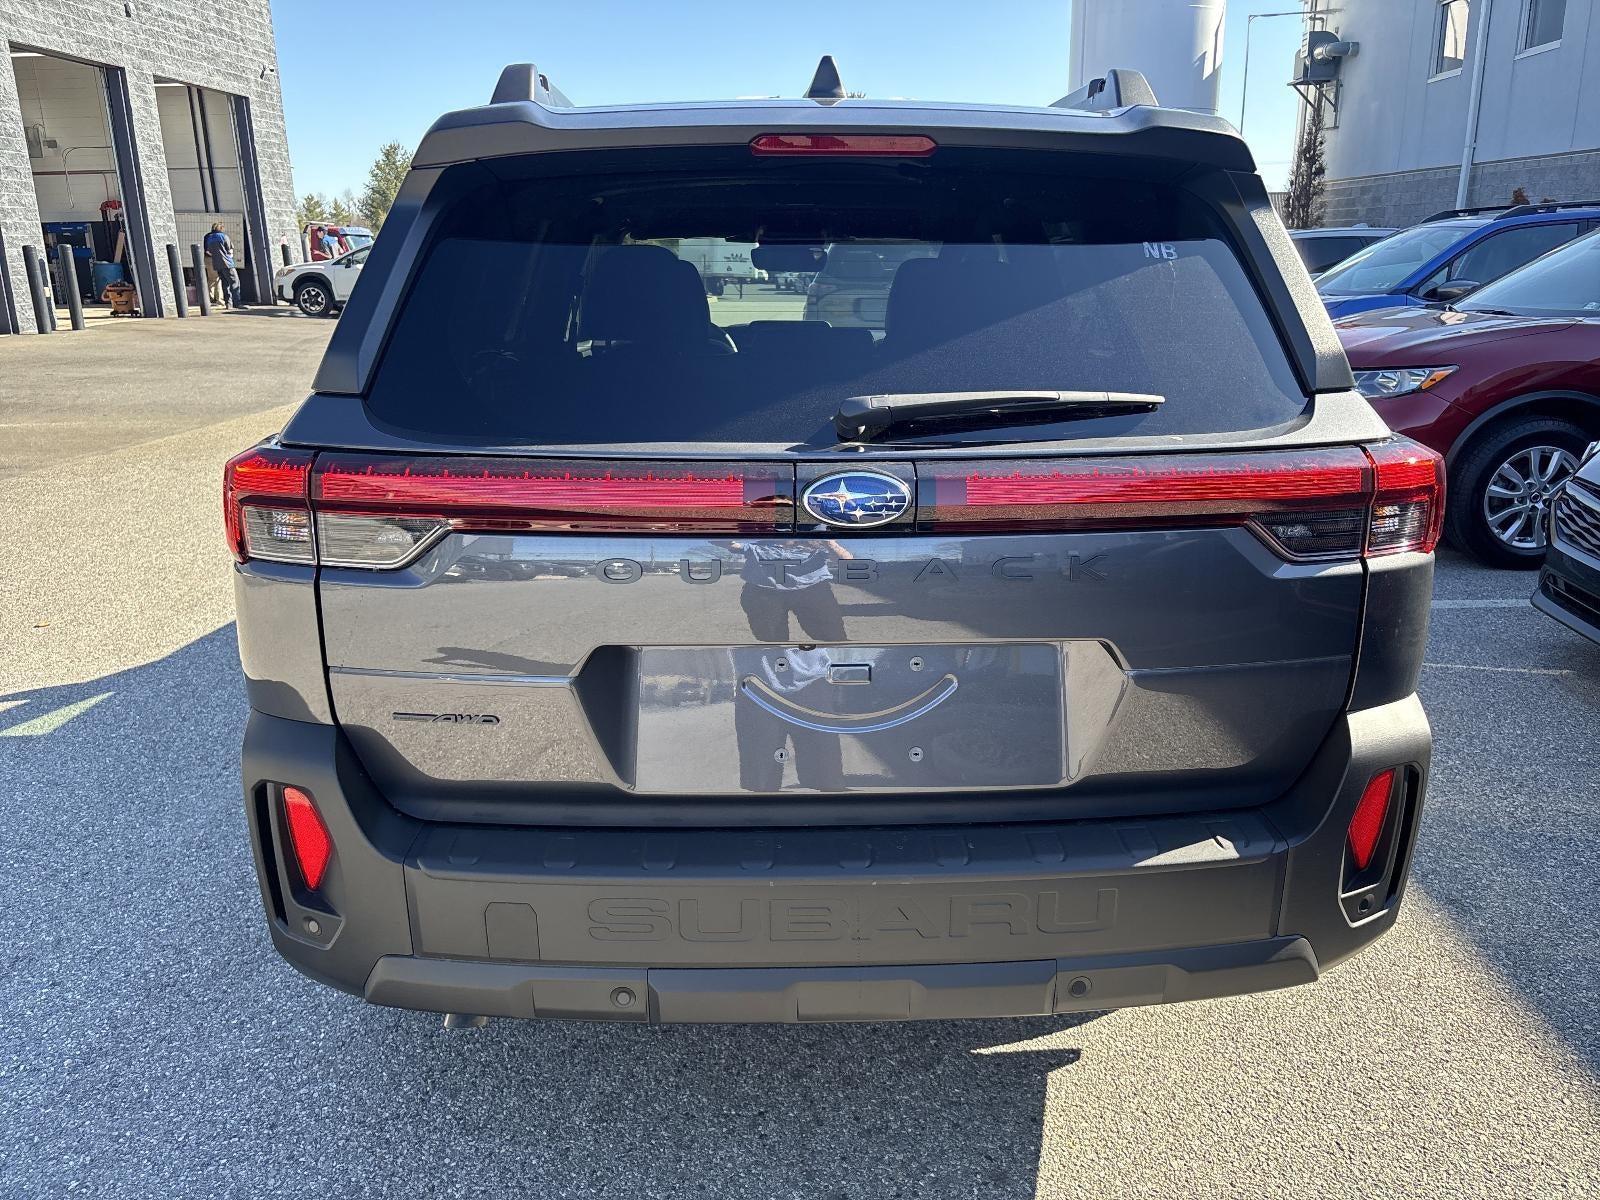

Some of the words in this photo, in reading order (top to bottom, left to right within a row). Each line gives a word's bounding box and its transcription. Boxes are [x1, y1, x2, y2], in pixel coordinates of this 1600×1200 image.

[1142, 241, 1178, 260] NB
[595, 554, 1109, 584] OUTBACK
[431, 713, 500, 725] AWD
[588, 887, 1119, 943] SUBARU
